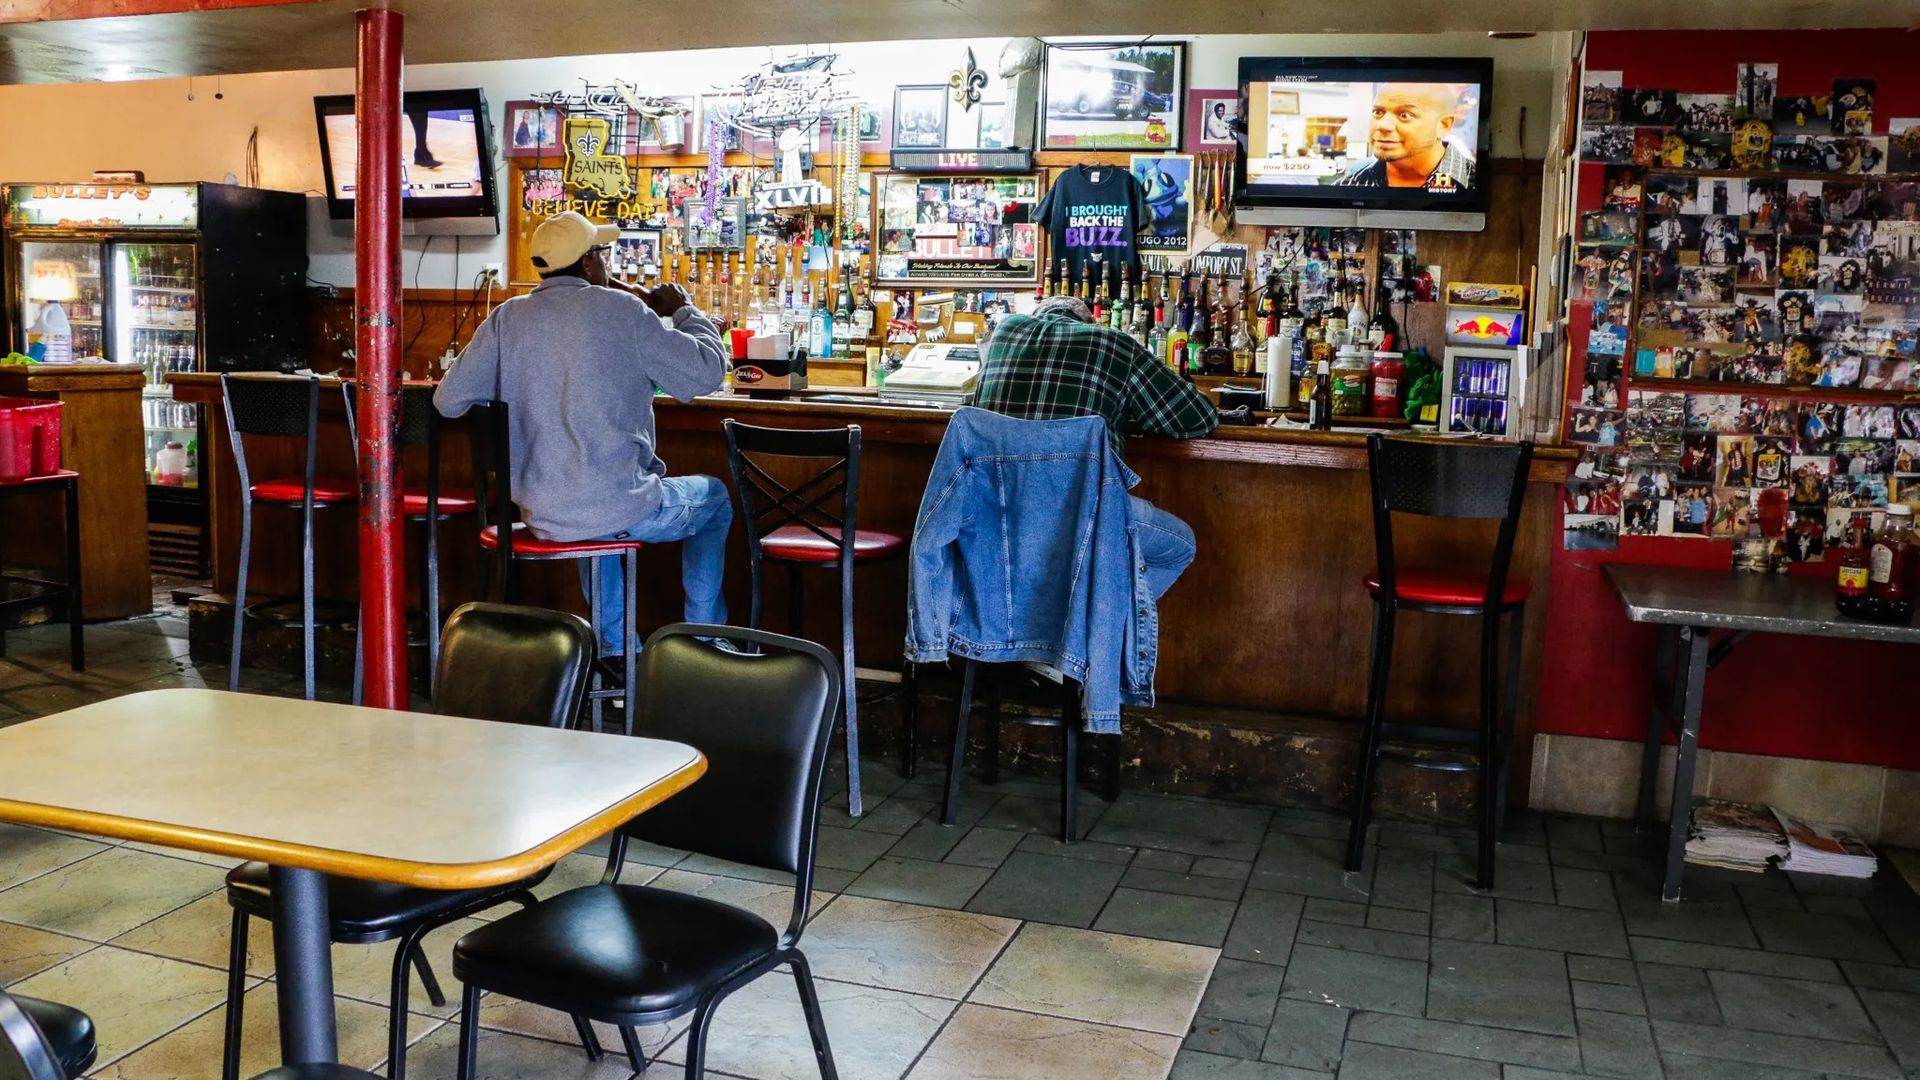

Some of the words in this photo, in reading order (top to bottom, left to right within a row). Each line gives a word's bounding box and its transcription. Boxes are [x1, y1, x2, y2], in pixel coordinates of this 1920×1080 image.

[574, 160, 623, 176] SAINTS
[1283, 162, 1311, 171] $250
[32, 185, 152, 200] BULLET'S
[532, 198, 608, 218] BELIEVE
[617, 201, 654, 221] DAT
[1071, 204, 1128, 217] BROUGHT
[1069, 216, 1101, 228] BACK
[1101, 216, 1124, 227] THE
[1065, 227, 1128, 247] BUZZ.
[1163, 236, 1187, 246] 2012
